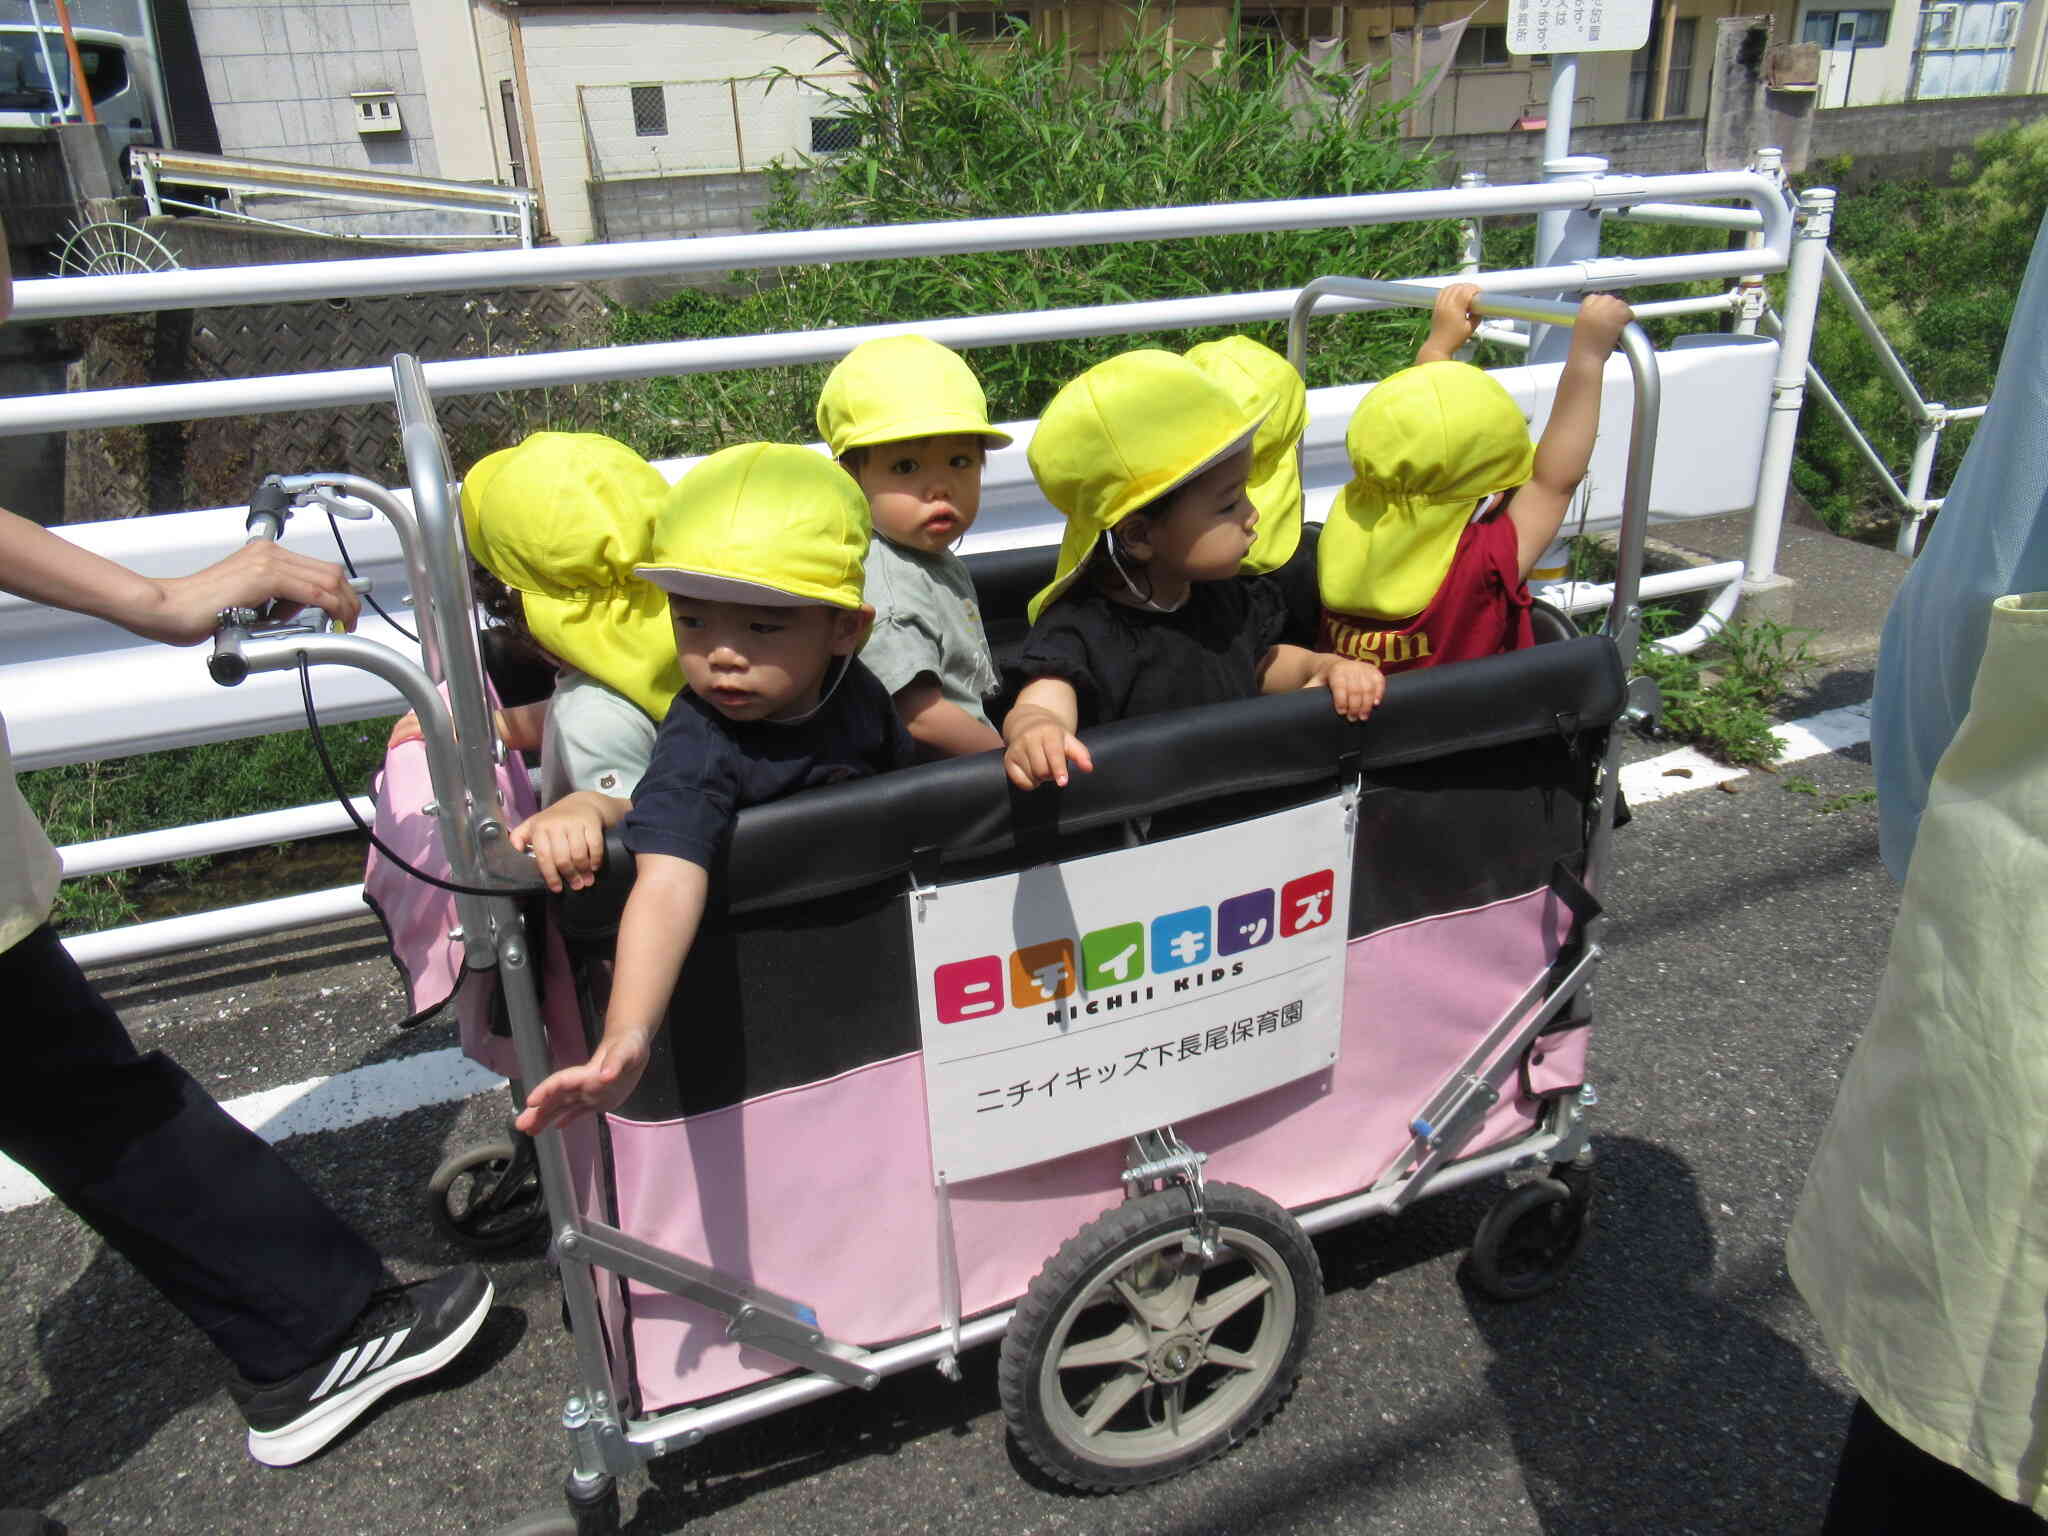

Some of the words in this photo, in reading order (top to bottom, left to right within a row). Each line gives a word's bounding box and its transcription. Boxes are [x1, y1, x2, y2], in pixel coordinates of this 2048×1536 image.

[958, 887, 1332, 1015] ニチイキッズ
[1046, 985, 1154, 1026] NICHII
[1174, 961, 1244, 993] KIDS
[976, 999, 1304, 1113] ニチイキッズ下長尾保育園
